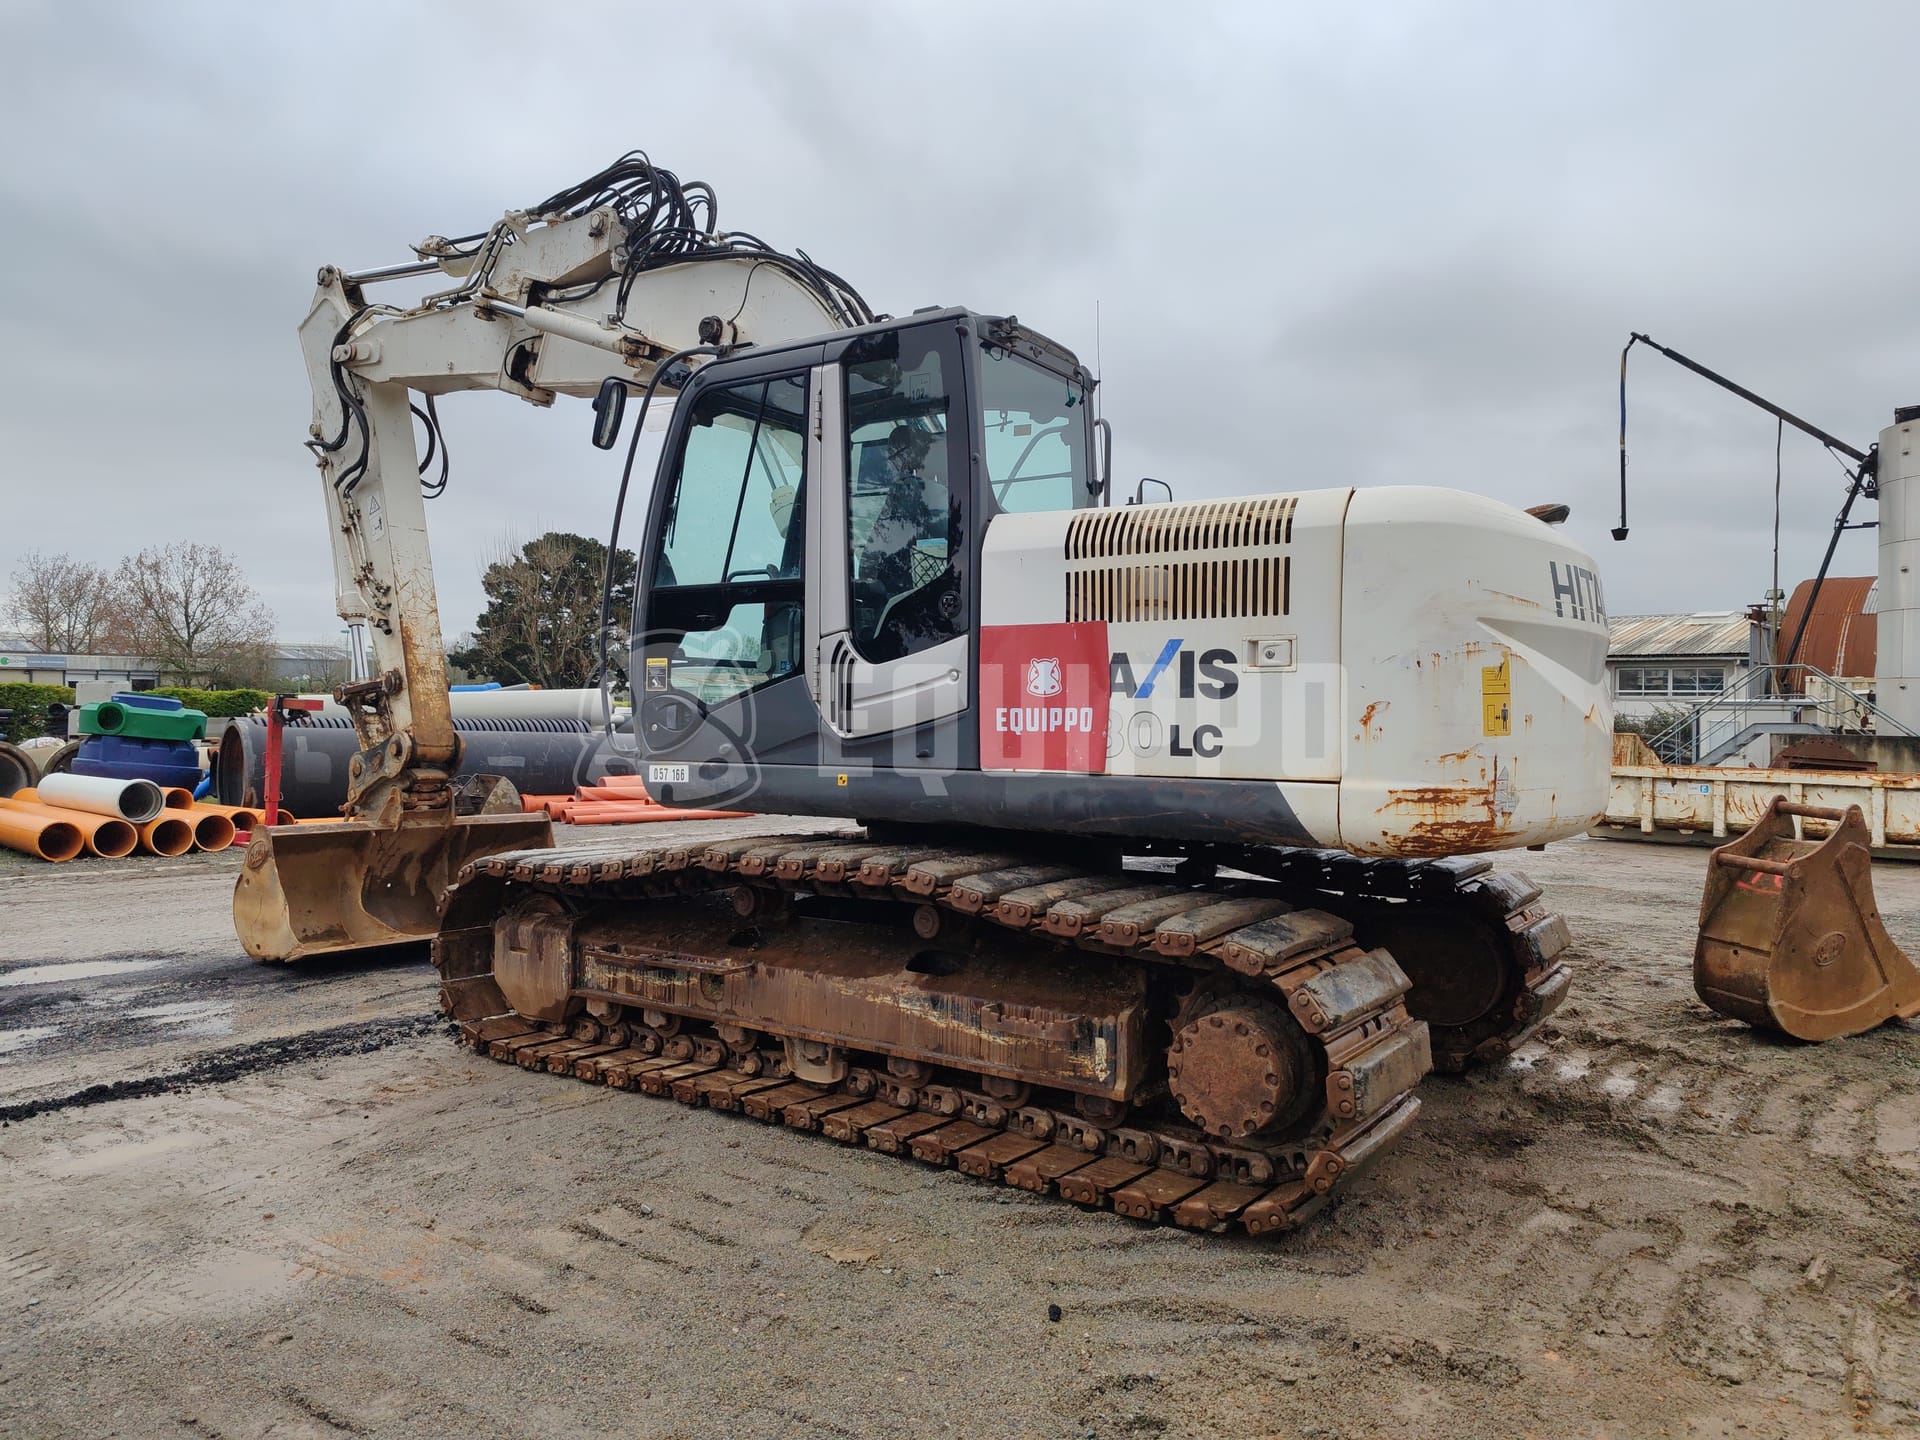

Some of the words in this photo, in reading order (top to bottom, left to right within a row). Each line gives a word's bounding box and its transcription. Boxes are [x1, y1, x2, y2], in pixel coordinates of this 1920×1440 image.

[996, 707, 1093, 735] EQUIPPO
[1169, 724, 1223, 758] LC
[672, 768, 685, 781] 166
